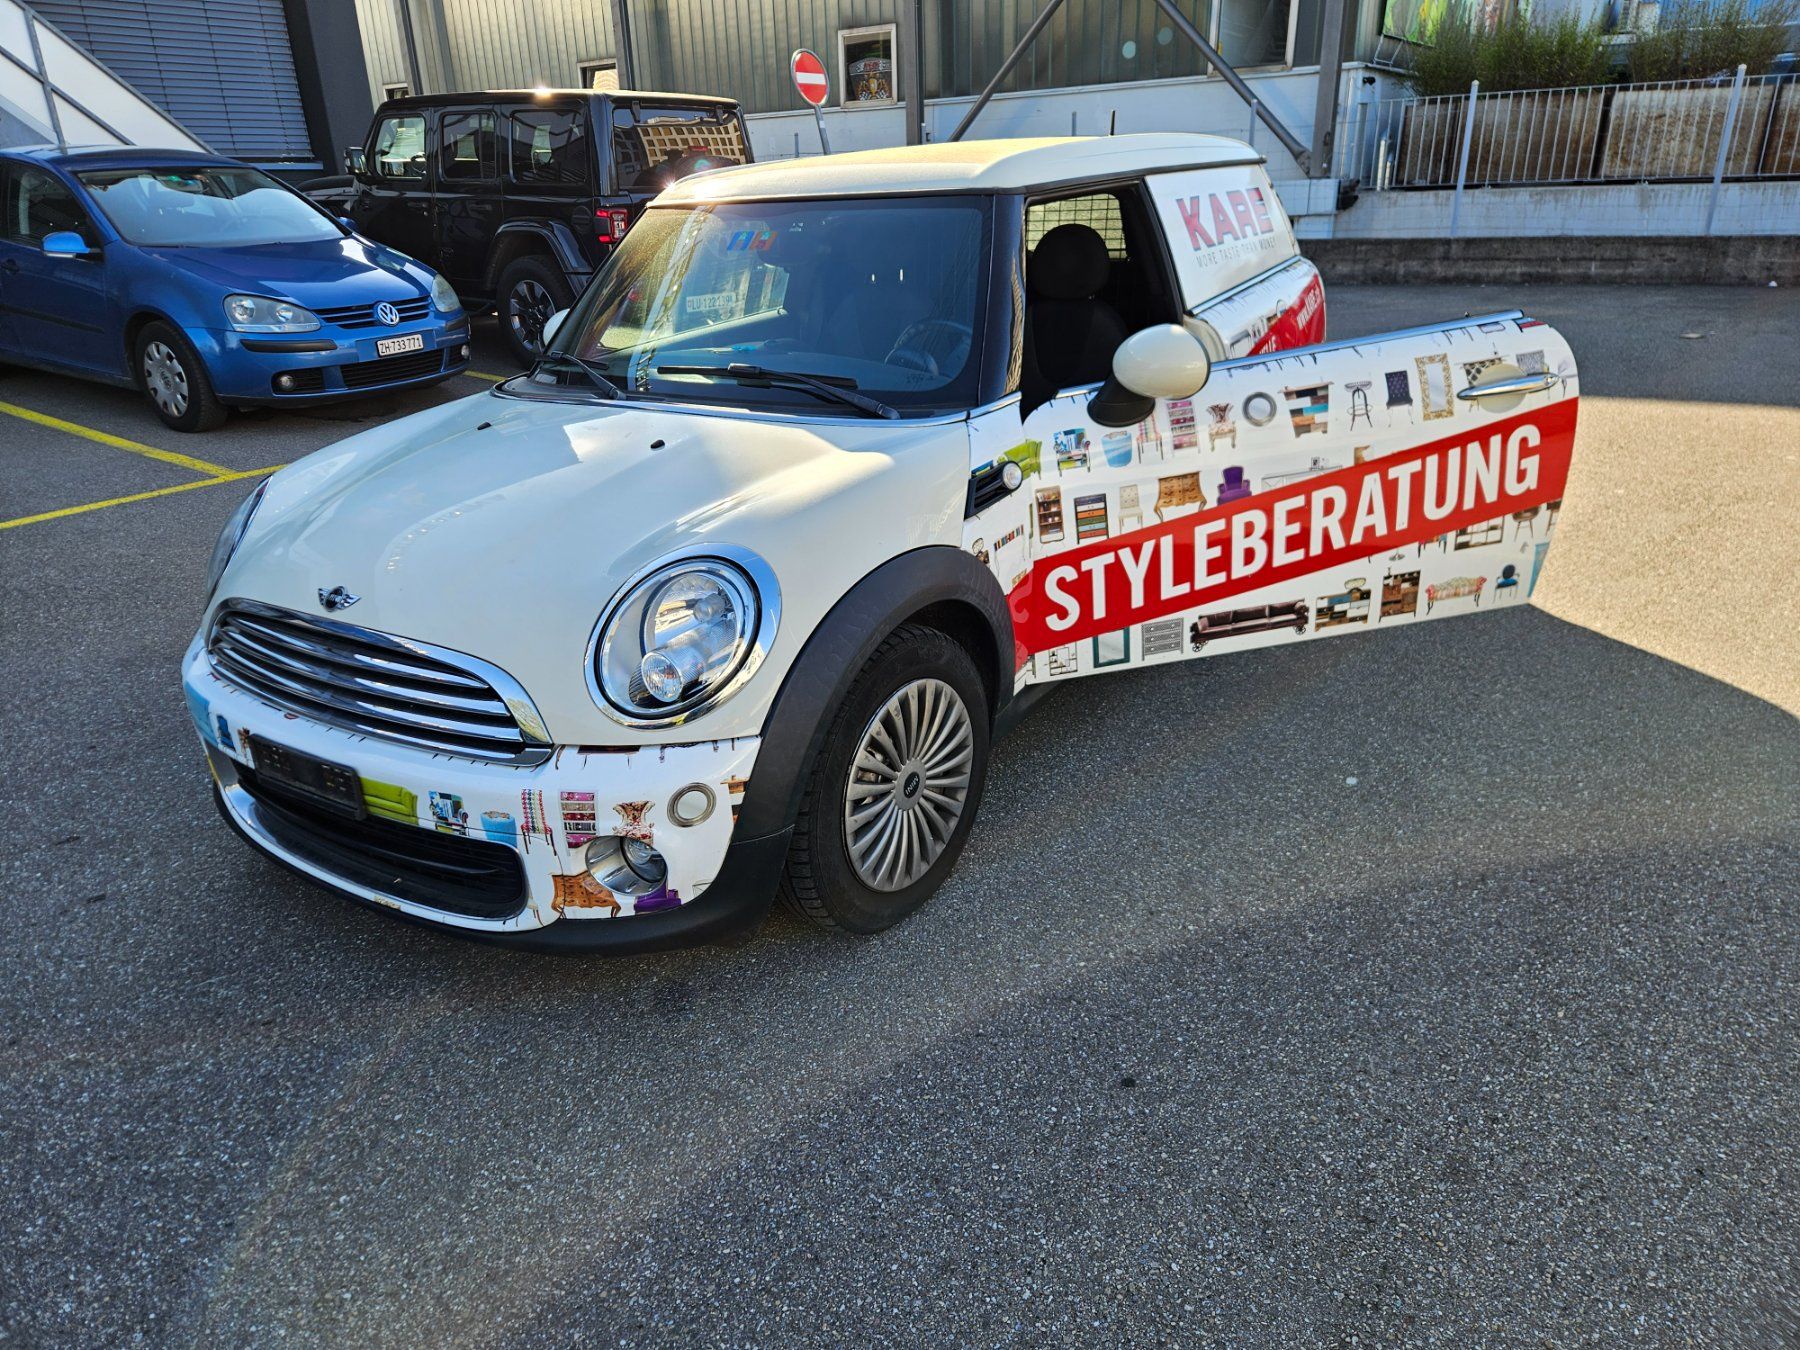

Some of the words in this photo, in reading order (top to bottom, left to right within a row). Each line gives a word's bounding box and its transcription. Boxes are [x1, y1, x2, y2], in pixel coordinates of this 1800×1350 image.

[1176, 188, 1273, 251] KARE
[1196, 251, 1218, 268] MORE
[1219, 245, 1241, 261] TASTE
[1044, 424, 1542, 632] STYLEBERATUNG
